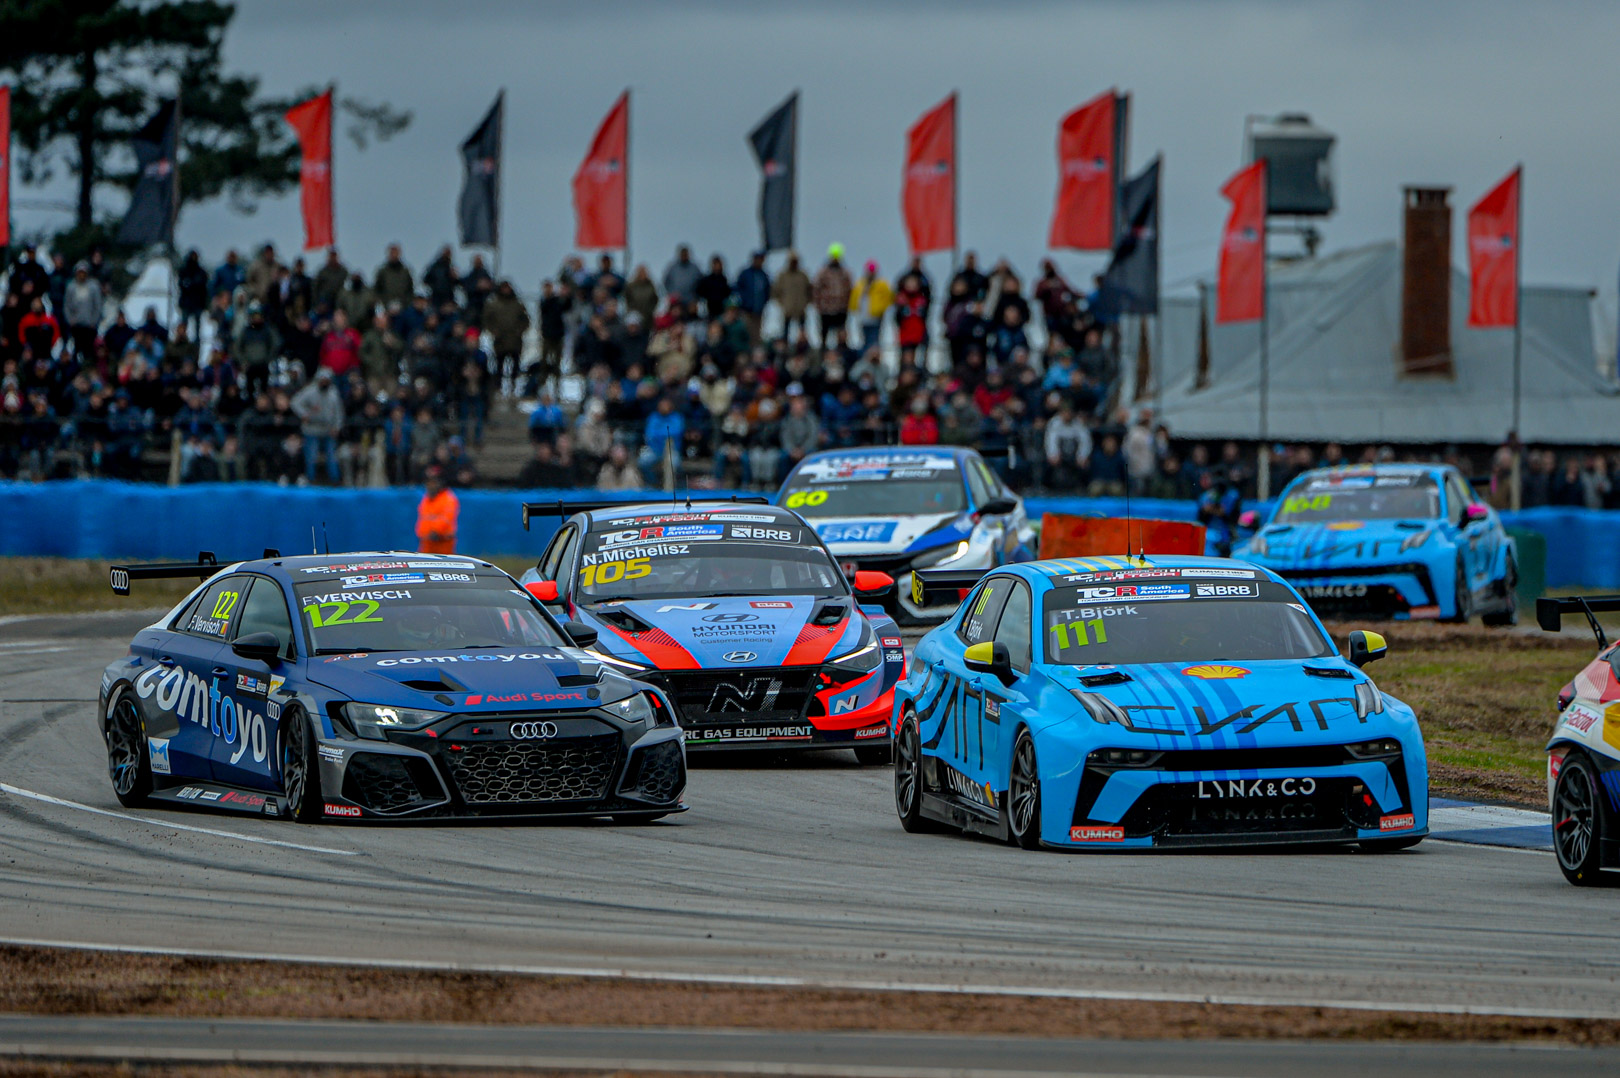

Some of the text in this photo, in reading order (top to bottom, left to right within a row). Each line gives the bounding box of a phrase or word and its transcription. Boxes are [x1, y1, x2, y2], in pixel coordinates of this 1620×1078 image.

[786, 490, 829, 508] 60
[600, 527, 664, 545] TCR
[752, 528, 792, 541] BRB
[583, 544, 690, 566] N.Michelisz
[443, 573, 471, 581] BRB
[579, 557, 652, 587] 105
[340, 574, 385, 586] TCR
[1076, 585, 1138, 599] TCR
[1215, 585, 1251, 596] BRB
[302, 590, 412, 606] F.VERVISCH
[974, 587, 994, 616] 111
[211, 591, 239, 620] 122
[303, 600, 384, 628] 122
[1060, 605, 1139, 621] T.Björk
[691, 624, 777, 632] HYUNDAI
[693, 629, 777, 638] MOTORSPORT
[1050, 619, 1108, 650] 111
[700, 637, 742, 645] Customer
[376, 652, 565, 666] comtoyou
[486, 691, 584, 703] Audi Sport
[704, 729, 732, 739] GAS
[735, 725, 813, 738] EQUIPMENT
[855, 726, 887, 737] KUMHO
[324, 804, 362, 816] KUMHO
[1381, 816, 1414, 829] KUMHO
[1071, 828, 1124, 840] KUMHO
